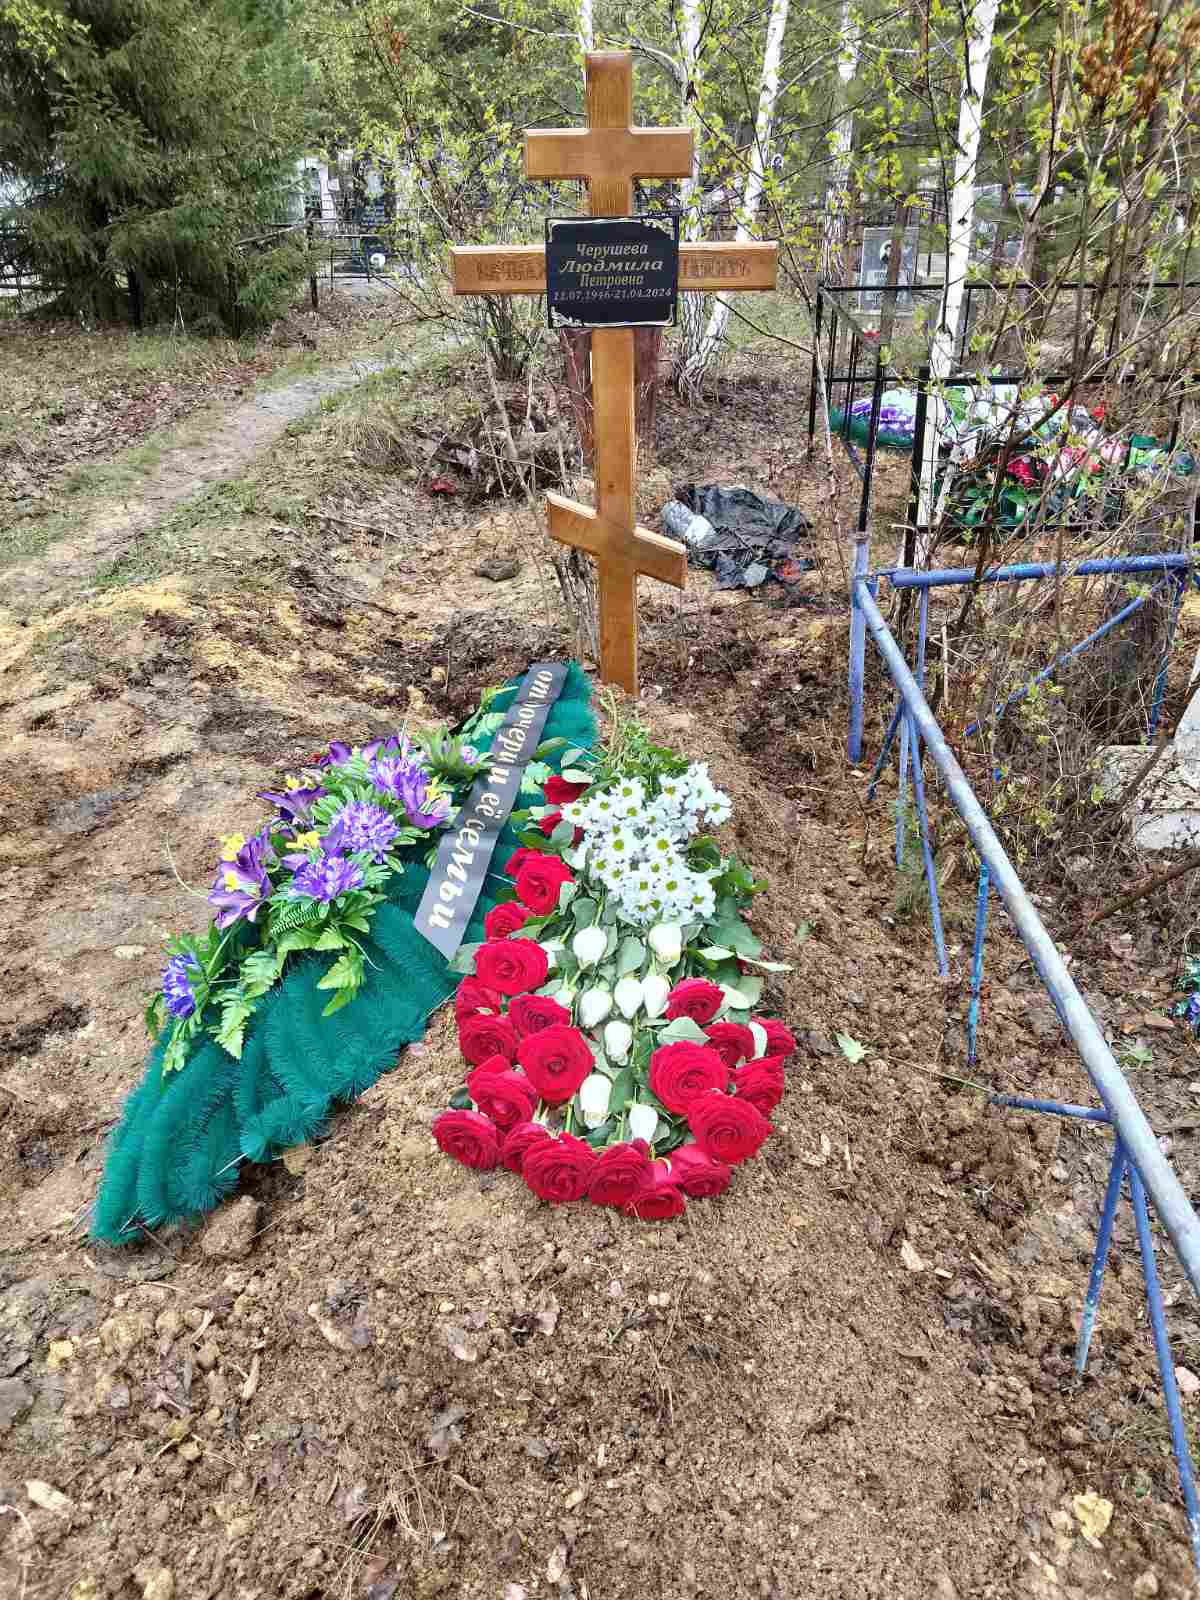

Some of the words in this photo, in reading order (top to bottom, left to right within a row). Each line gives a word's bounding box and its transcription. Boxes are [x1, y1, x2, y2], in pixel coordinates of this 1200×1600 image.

[576, 243, 649, 259] Черушева
[559, 259, 664, 274] Людмила
[580, 273, 645, 289] Петровна
[527, 670, 553, 699] от
[487, 766, 510, 786] и
[475, 792, 504, 819] её
[427, 818, 486, 930] семьи
